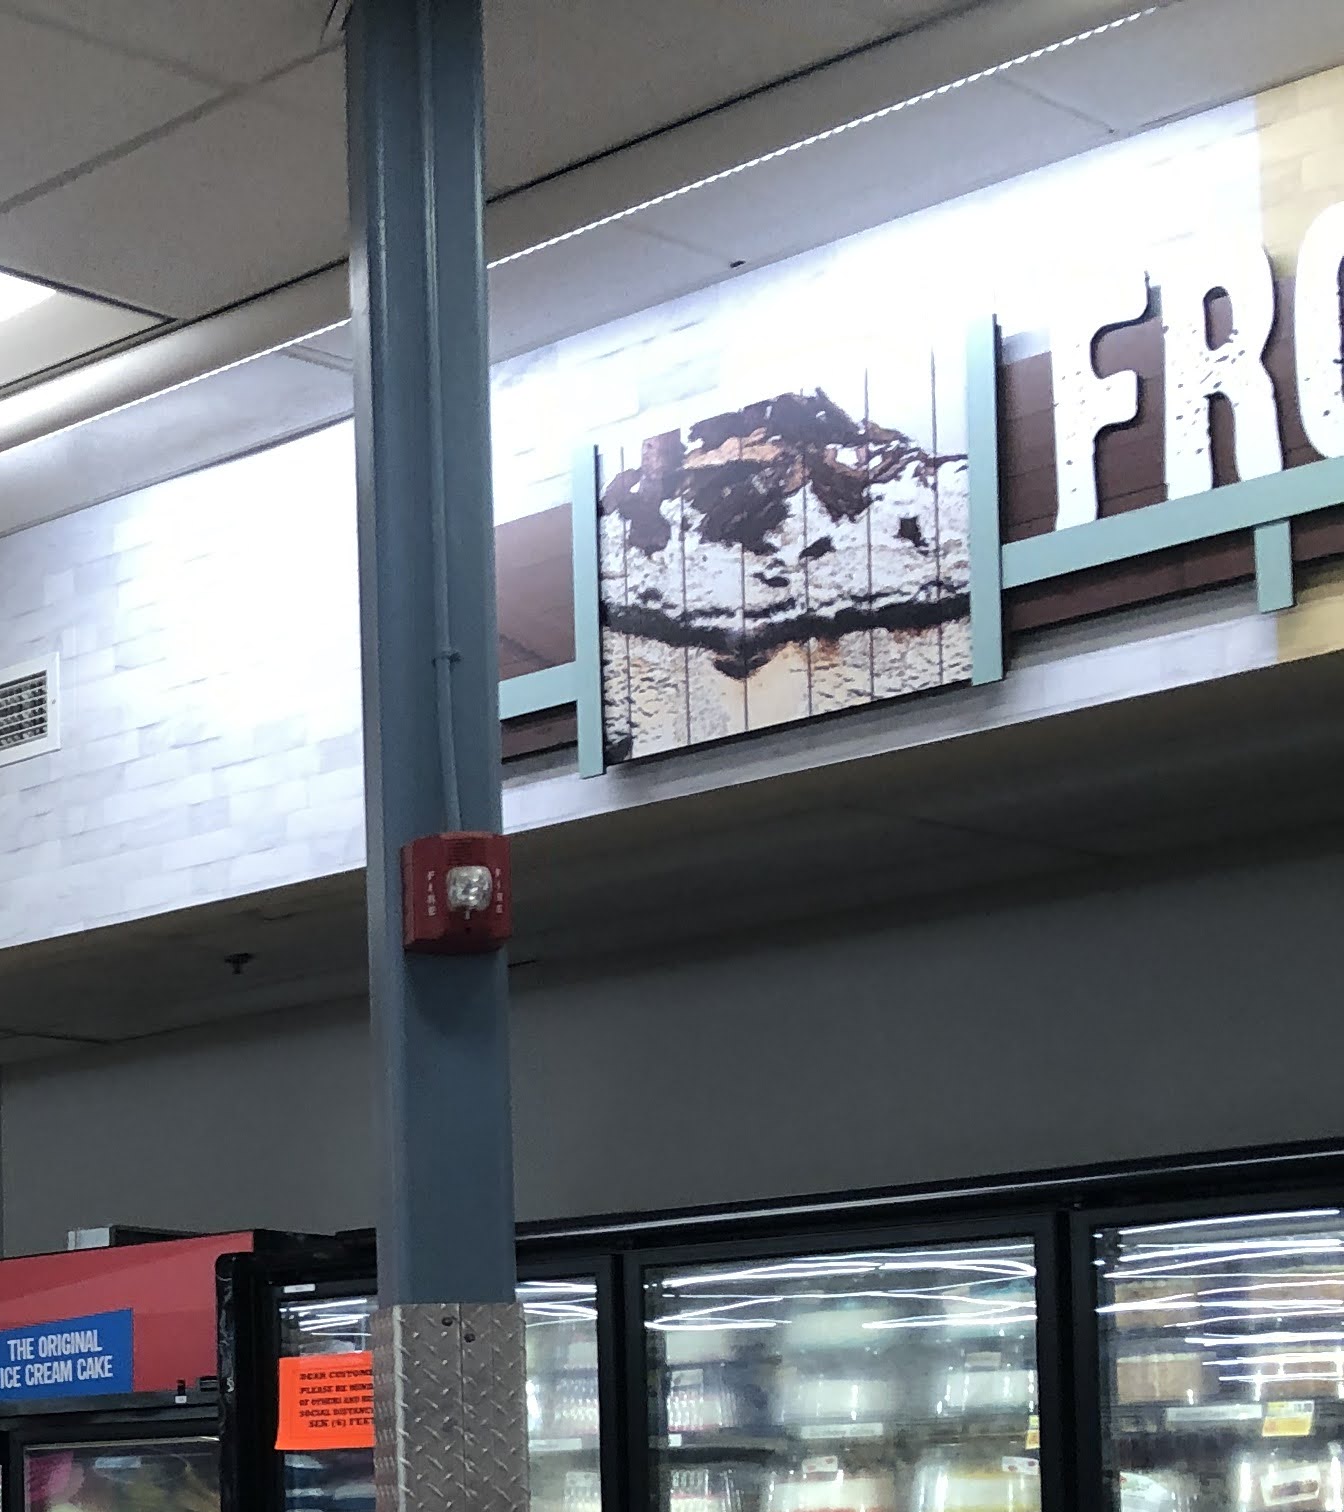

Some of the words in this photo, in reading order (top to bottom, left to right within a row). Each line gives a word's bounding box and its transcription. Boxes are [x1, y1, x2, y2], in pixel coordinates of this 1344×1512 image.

[7, 1337, 35, 1361] THE
[37, 1329, 104, 1357] ORIGINAL
[0, 1366, 22, 1389] ICE
[24, 1359, 74, 1387] CREAM
[76, 1354, 114, 1381] CAKE
